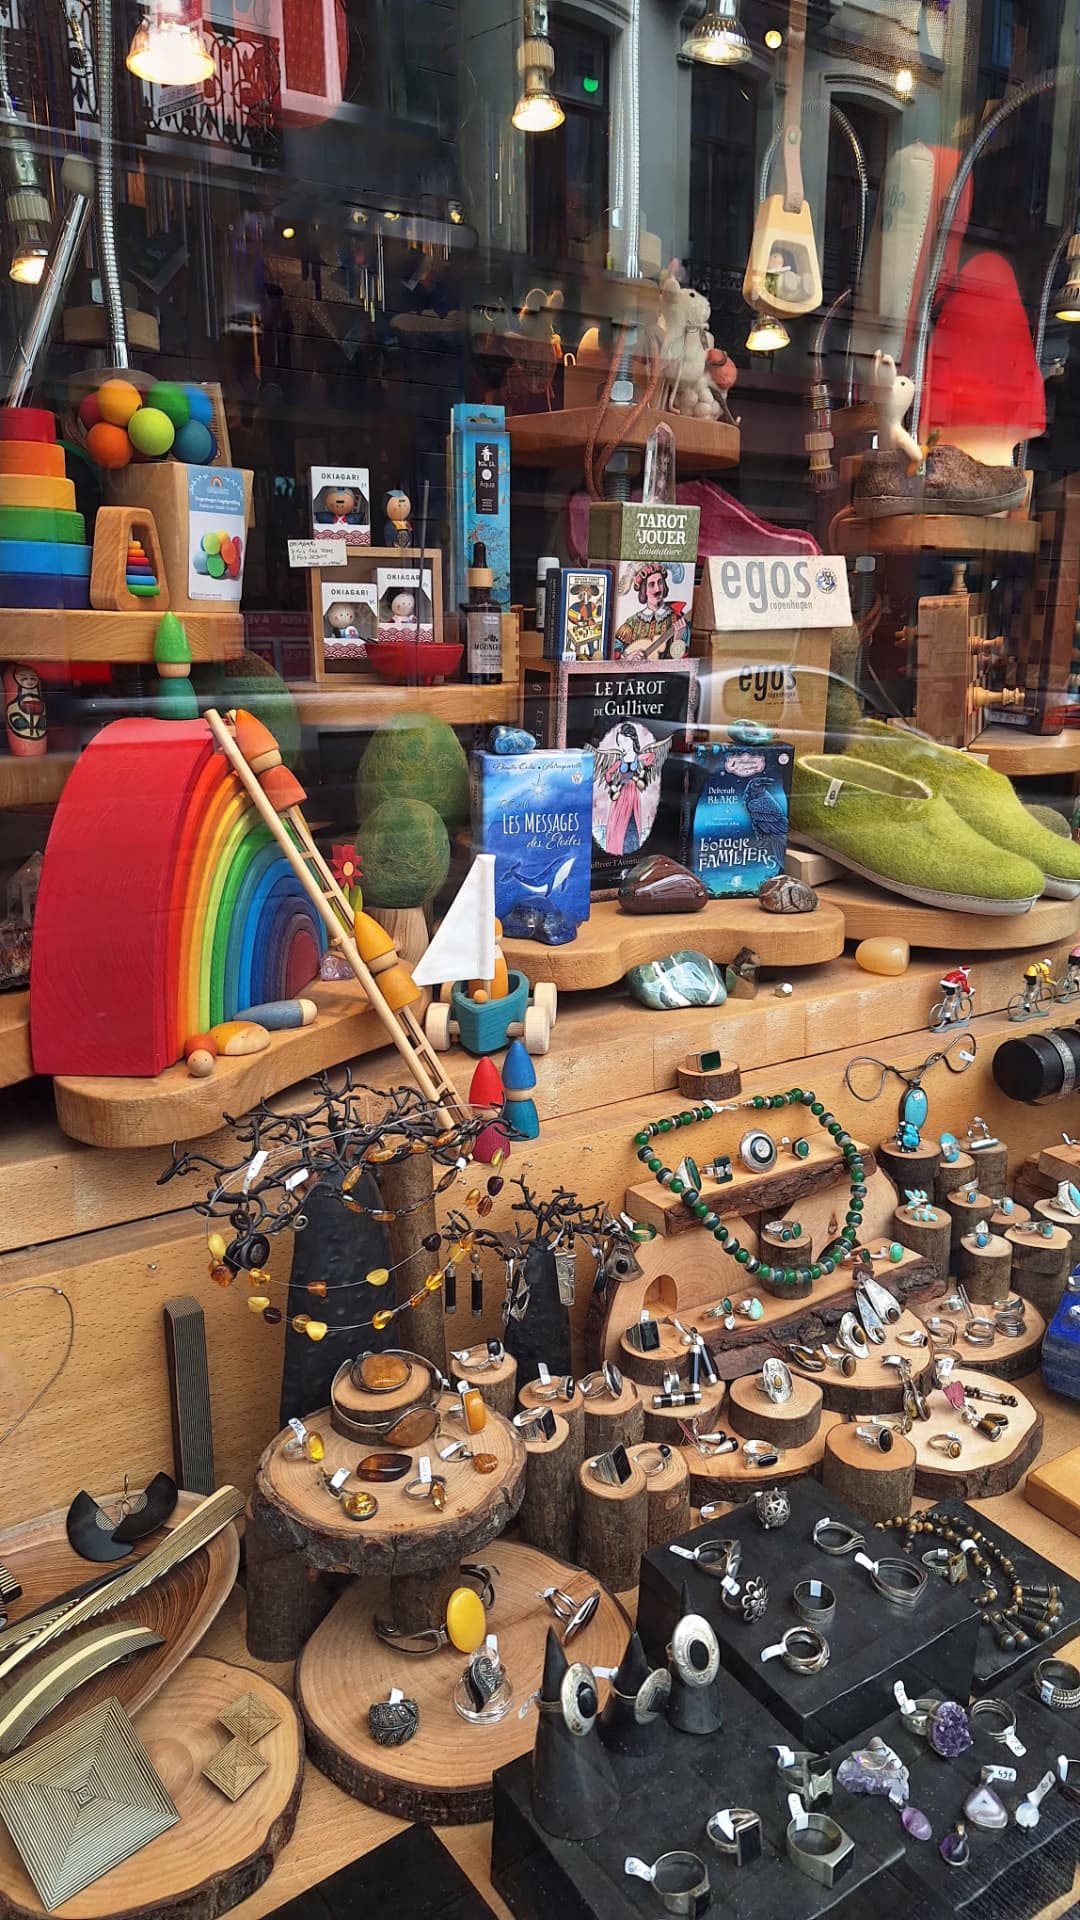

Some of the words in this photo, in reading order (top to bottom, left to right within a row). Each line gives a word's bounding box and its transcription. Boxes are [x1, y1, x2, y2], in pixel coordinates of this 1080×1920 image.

[321, 472, 360, 480] OKIAGARI
[480, 481, 495, 489] Aqua
[637, 513, 688, 528] TAROT
[639, 530, 687, 545] JOUER
[331, 588, 369, 596] OKIAGARI
[720, 560, 812, 613] egos
[770, 599, 813, 612] copenhagen
[595, 681, 614, 696] LE
[615, 680, 665, 696] TAROT
[738, 664, 797, 701] egos
[604, 699, 664, 716] Gulliver
[708, 786, 736, 795] Deborah
[707, 795, 739, 805] BLAKE
[503, 813, 520, 834] LES
[525, 811, 580, 833] MESSAGES
[526, 836, 542, 848] des
[700, 837, 750, 851] L'oracle
[590, 861, 612, 869] ulliver
[699, 846, 777, 872] FAMILIERS
